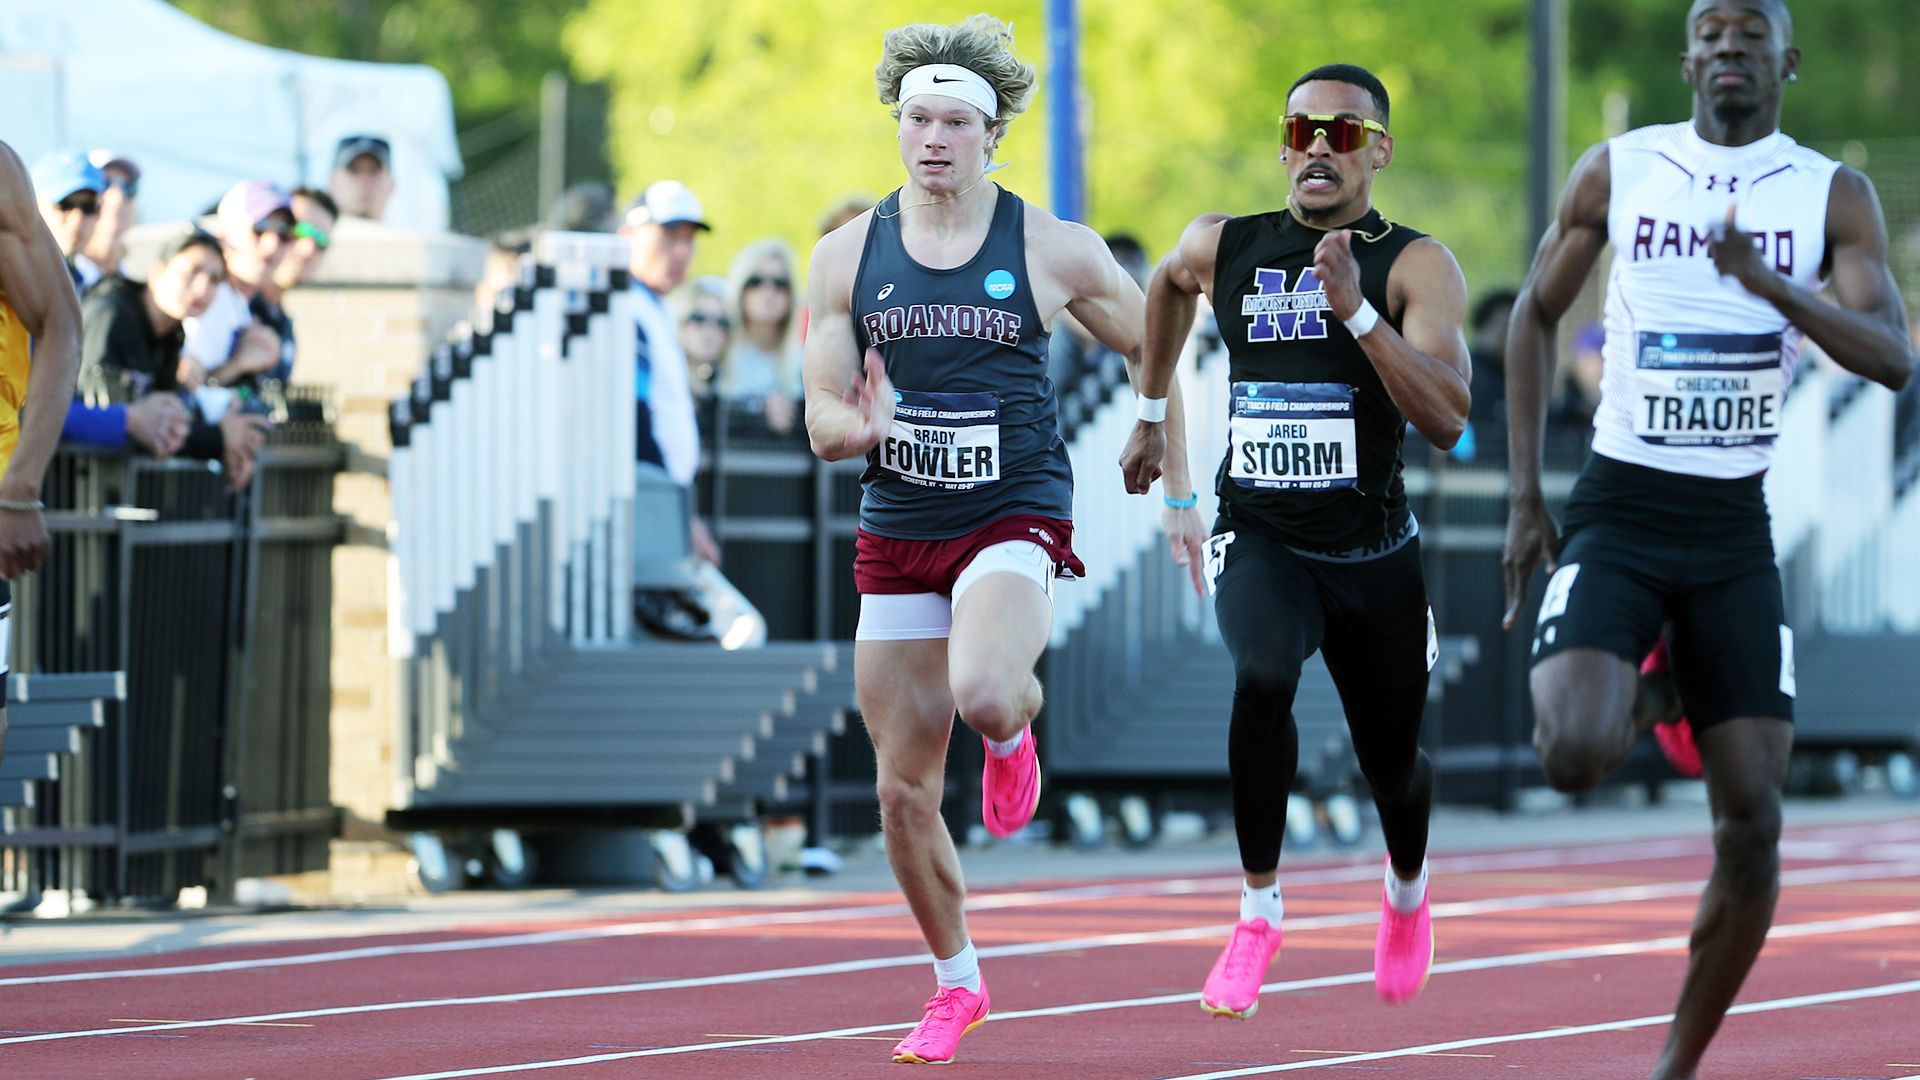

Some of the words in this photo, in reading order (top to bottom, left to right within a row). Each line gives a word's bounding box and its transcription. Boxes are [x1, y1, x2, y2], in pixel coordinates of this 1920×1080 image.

[1633, 216, 1793, 276] RAMO
[988, 283, 1014, 292] NCAA
[1244, 297, 1291, 311] MOUNT
[863, 304, 1021, 347] ROANOKE
[1247, 401, 1265, 411] TRACK
[1271, 401, 1289, 411] FIELD
[1289, 402, 1350, 411] CHAMPIONSHIPS
[1644, 394, 1774, 431] TRAORE
[918, 410, 937, 418] FIELD
[938, 410, 996, 419] CHAMPIONSHIPS
[914, 429, 956, 445] BRADY
[1267, 424, 1307, 438] JARED
[885, 436, 993, 479] FOWLER
[1242, 441, 1343, 476] STORM
